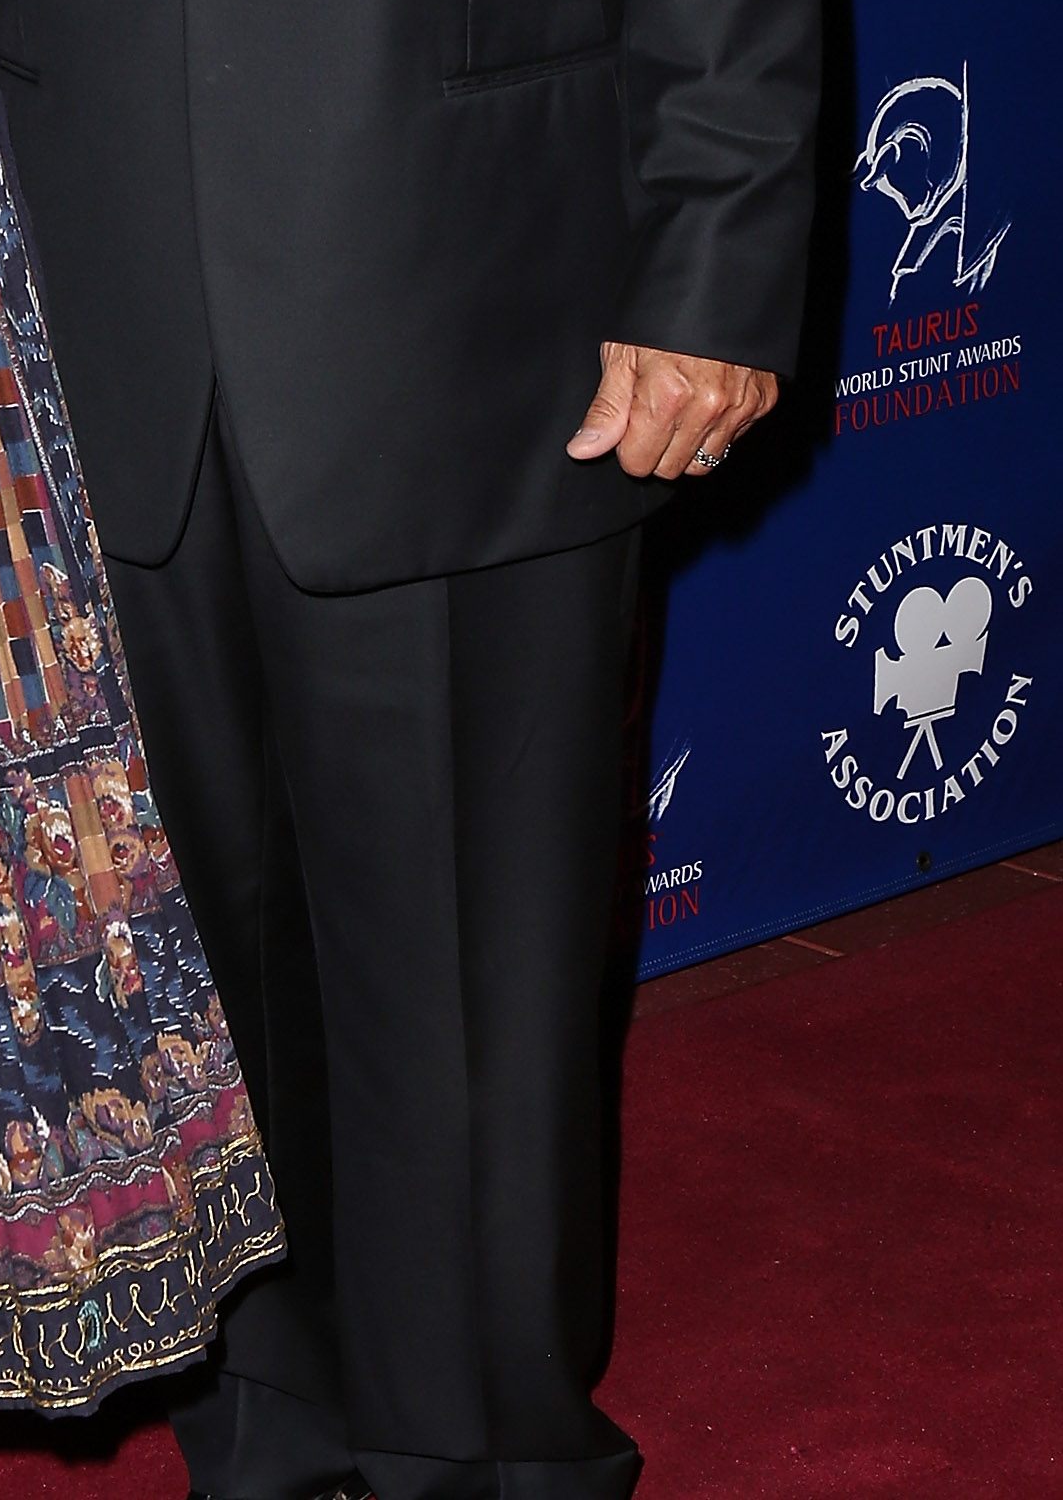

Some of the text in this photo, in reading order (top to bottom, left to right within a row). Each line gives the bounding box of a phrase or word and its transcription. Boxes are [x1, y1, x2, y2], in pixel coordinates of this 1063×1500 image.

[836, 335, 1022, 398] WORLD STUNT AWARDS
[836, 361, 1020, 435] FOUNDATION
[835, 524, 1033, 647] STUNTMEN'S
[820, 673, 1033, 824] ASSOCIATION
